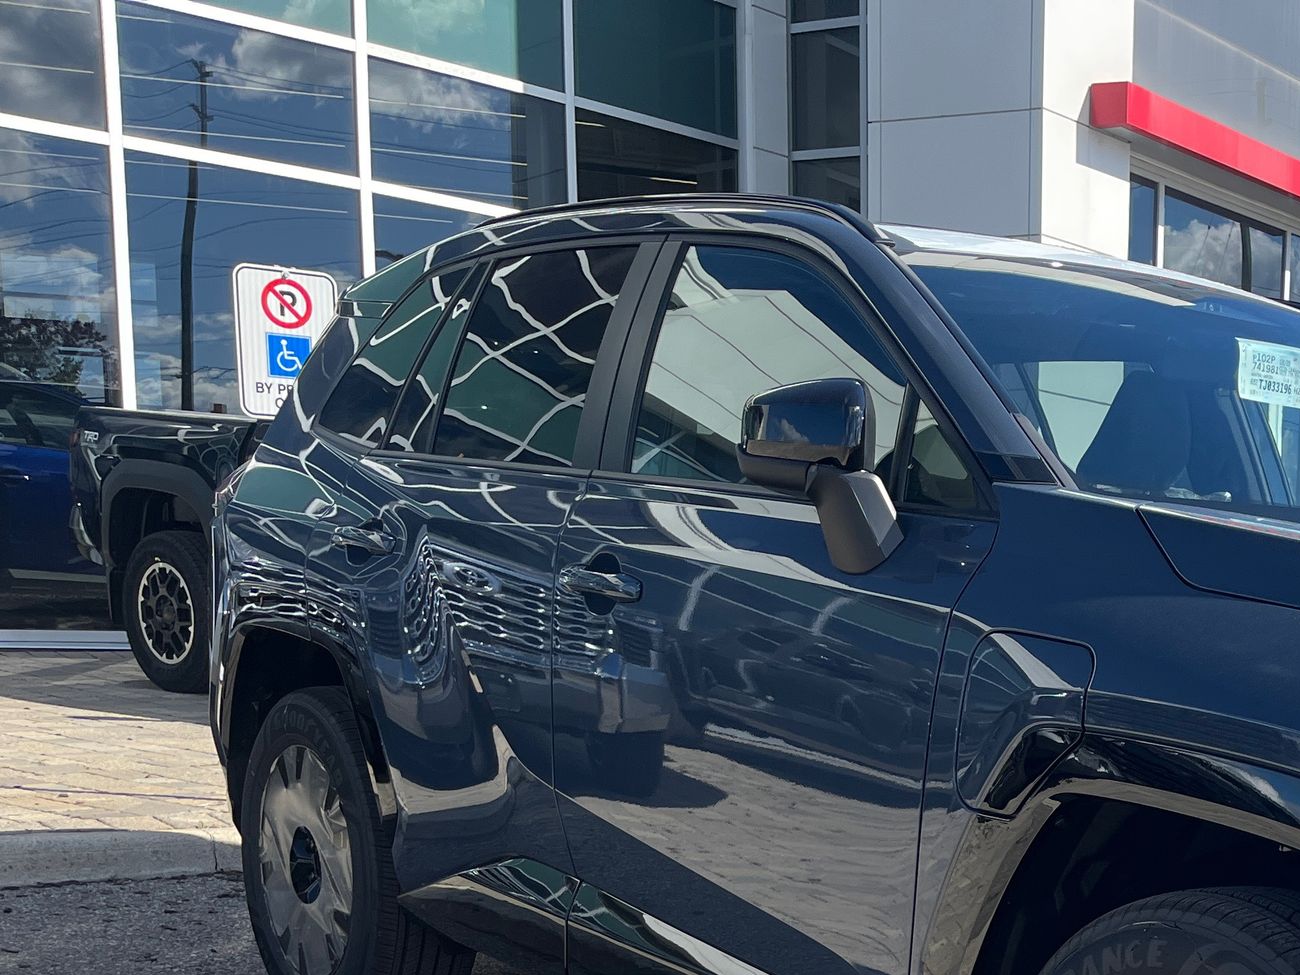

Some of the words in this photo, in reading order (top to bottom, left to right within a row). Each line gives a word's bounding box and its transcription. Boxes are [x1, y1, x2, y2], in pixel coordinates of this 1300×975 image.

[1252, 362, 1279, 375] 741981
[256, 382, 272, 394] BY
[1258, 379, 1292, 395] TJ033196
[84, 430, 99, 443] TRD
